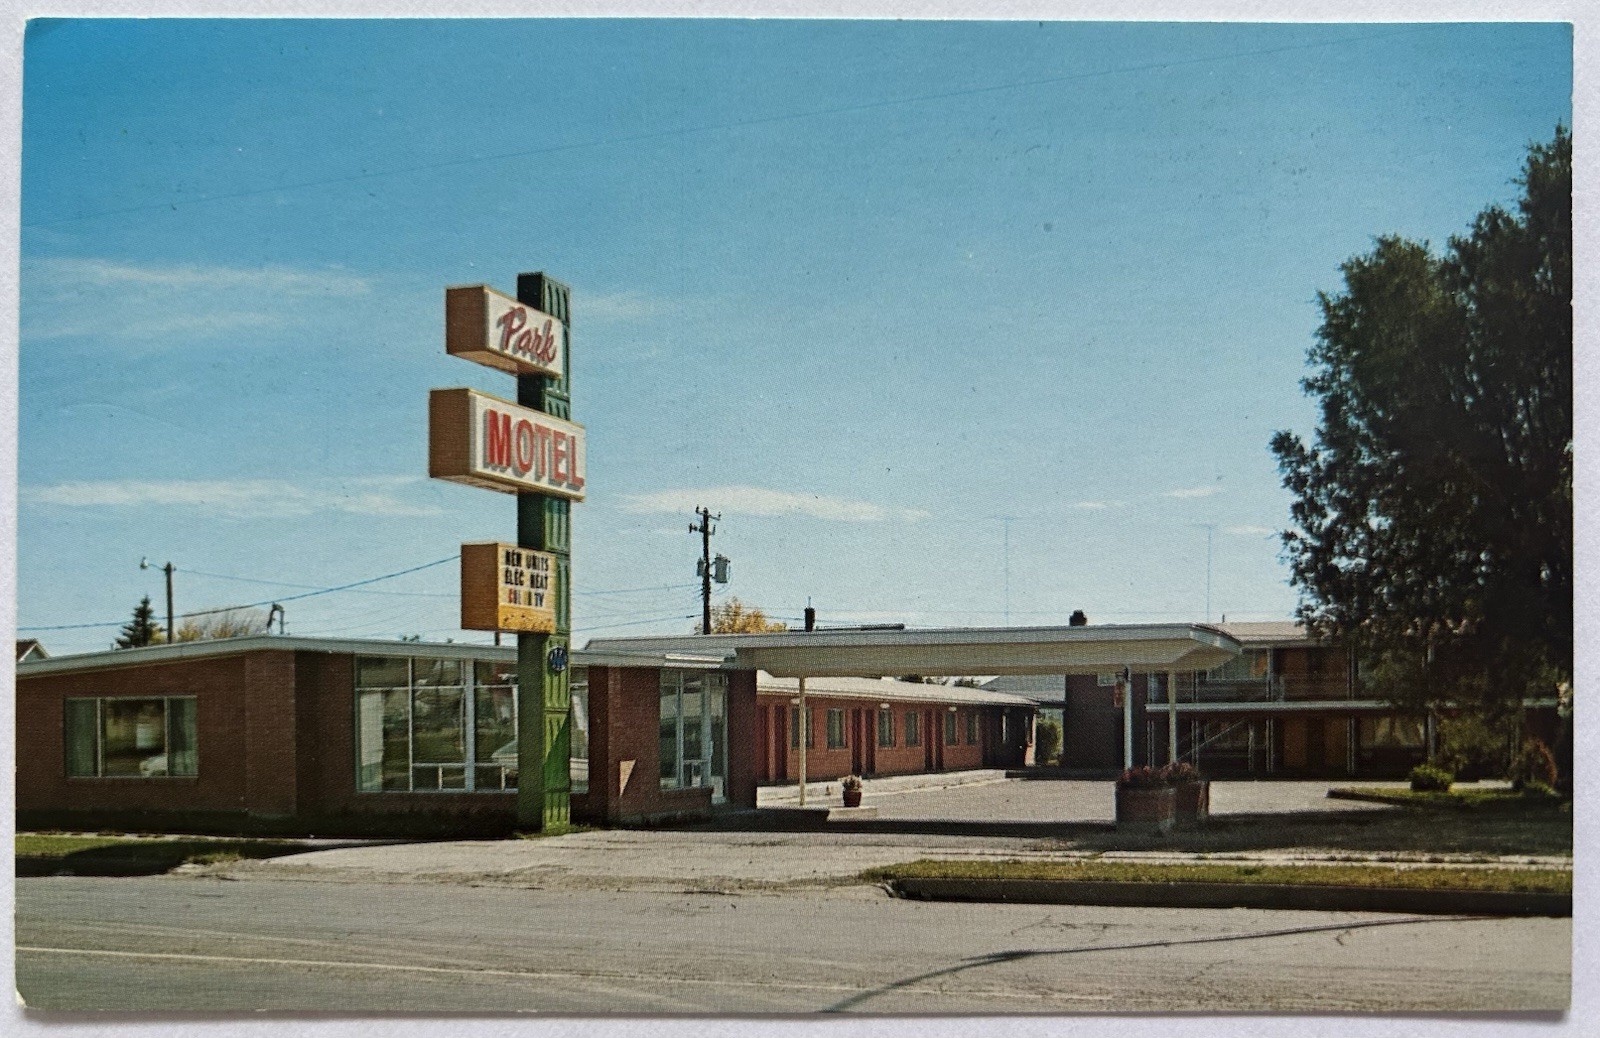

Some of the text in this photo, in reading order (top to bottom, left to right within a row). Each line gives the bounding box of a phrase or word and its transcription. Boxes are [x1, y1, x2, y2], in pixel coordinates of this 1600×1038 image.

[497, 306, 557, 364] Park
[484, 409, 584, 489] MOTEL
[506, 549, 549, 571] NEW UNITS
[505, 567, 524, 586] ELEC
[534, 592, 544, 607] TV
